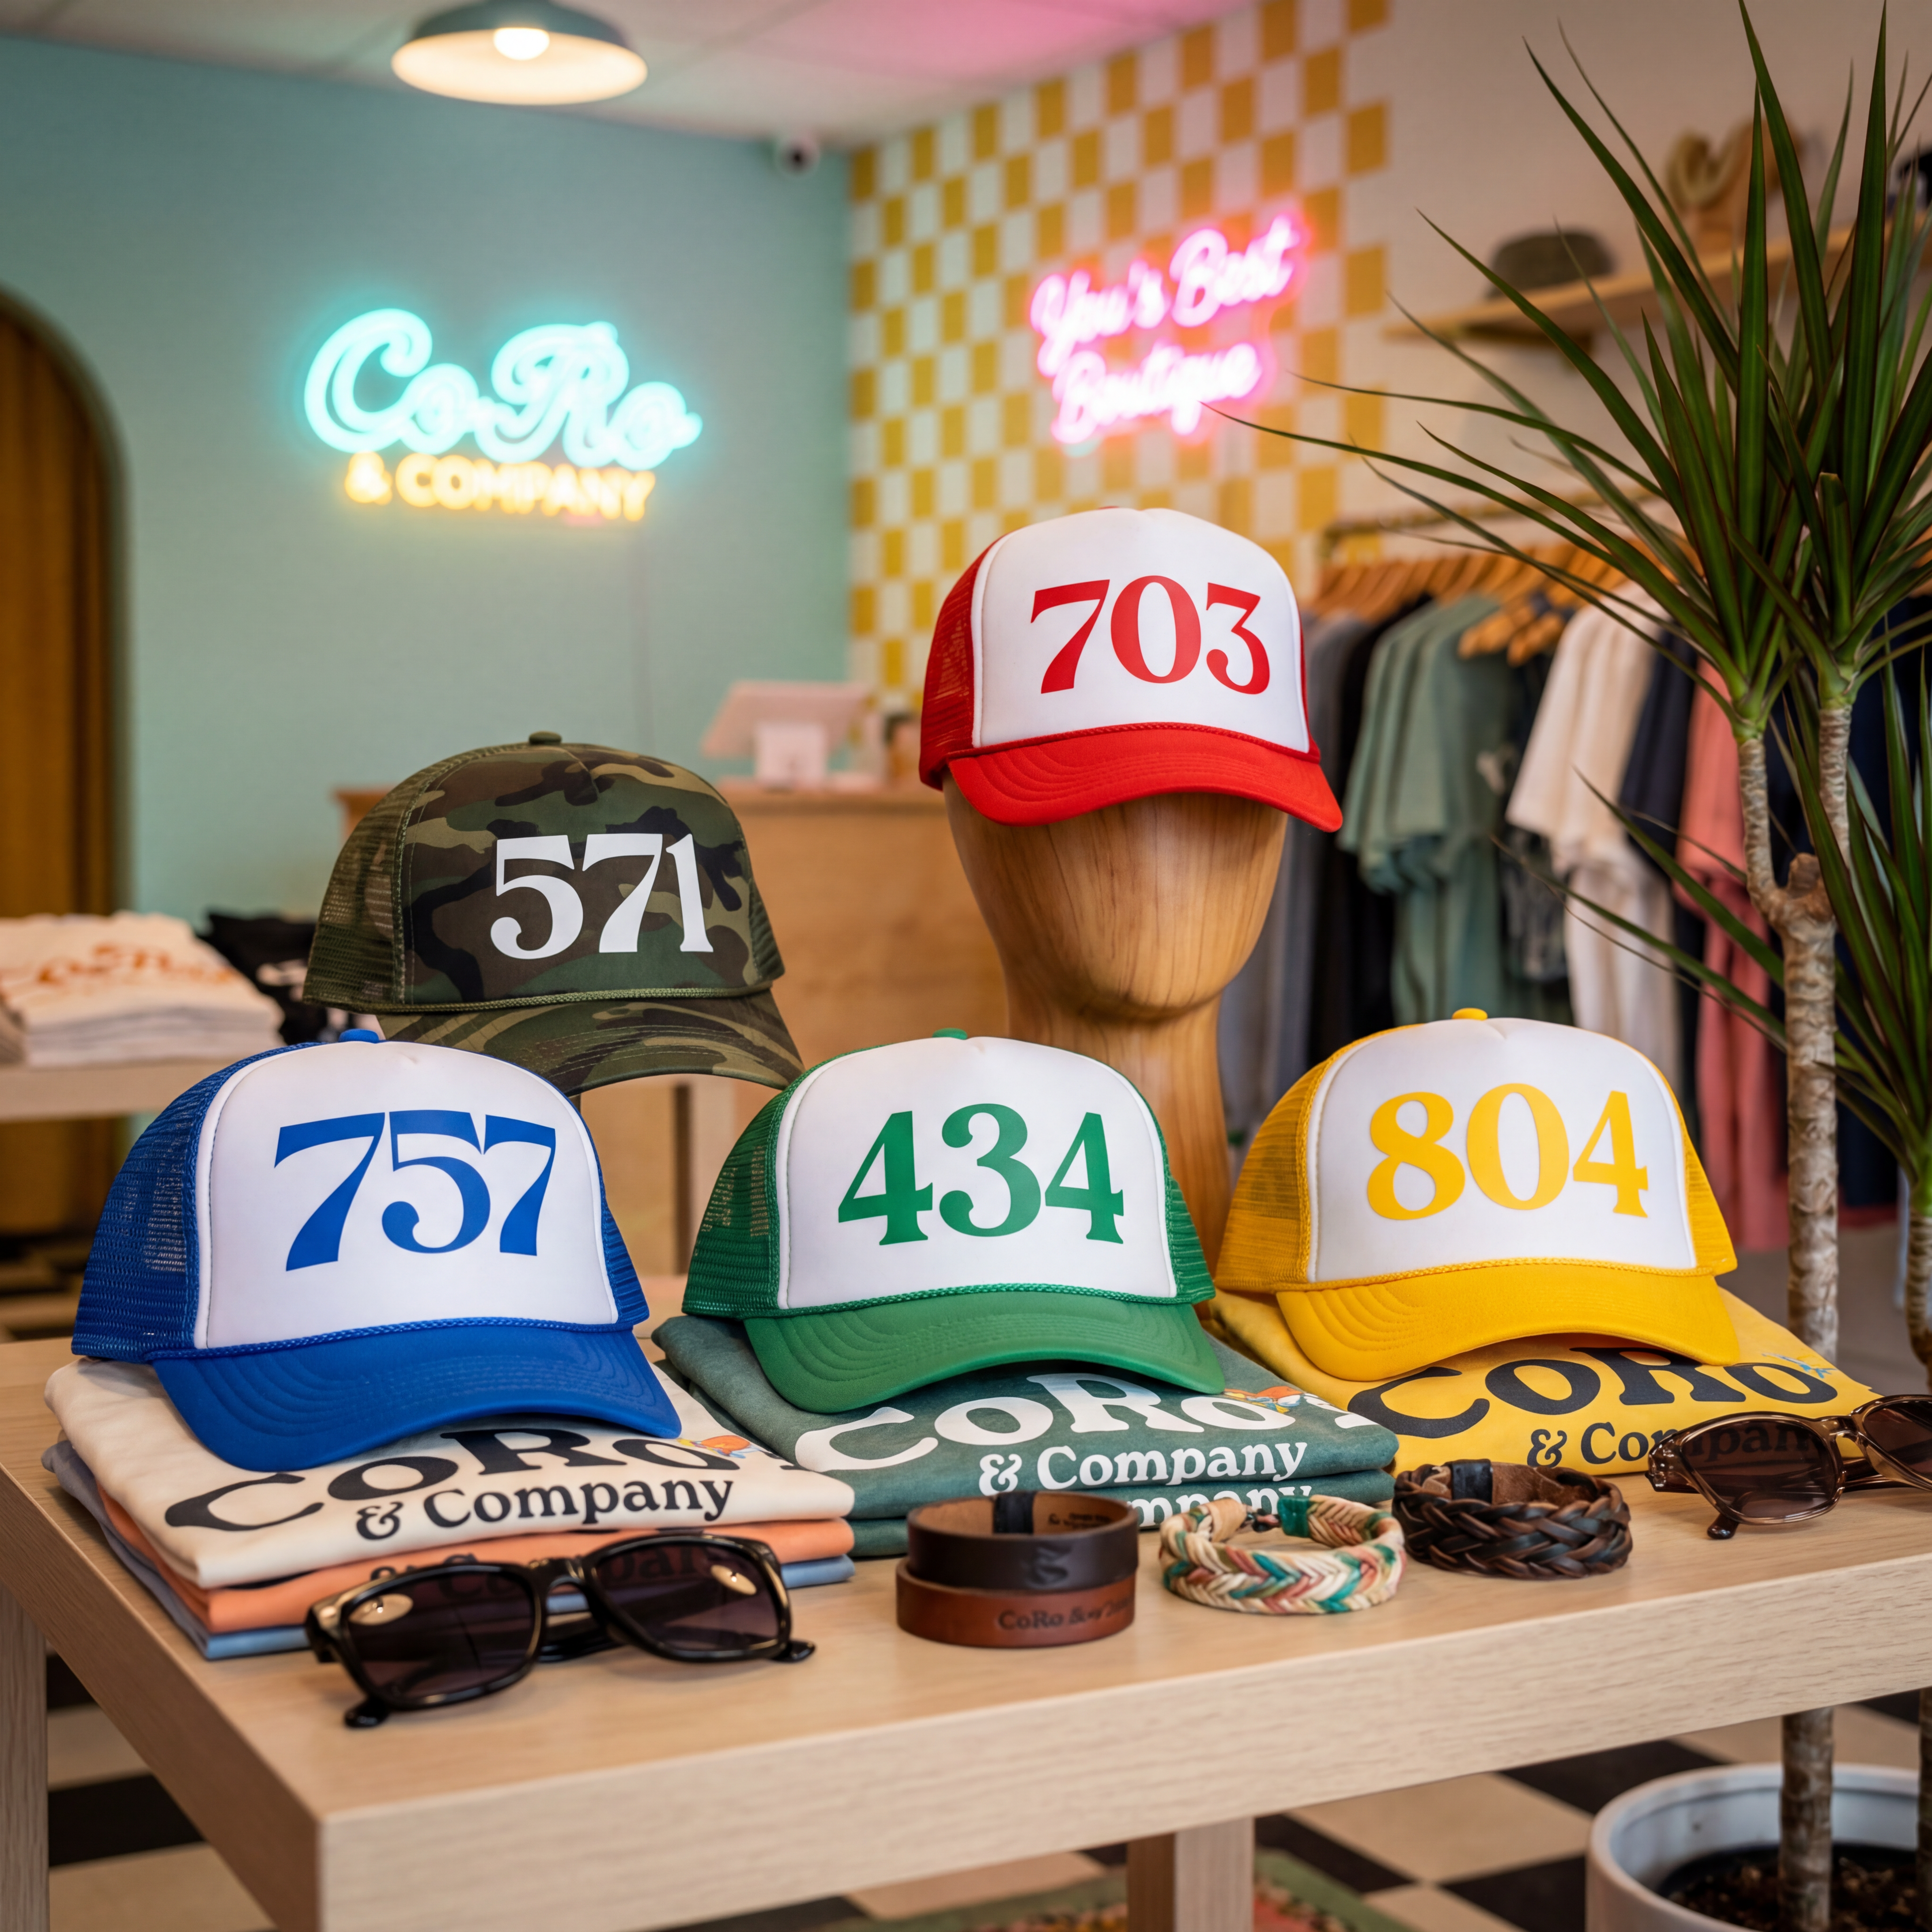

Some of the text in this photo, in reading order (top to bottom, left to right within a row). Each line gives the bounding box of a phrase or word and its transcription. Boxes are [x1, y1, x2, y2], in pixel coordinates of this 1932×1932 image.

[345, 450, 656, 521] & COMPANY
[1030, 575, 1270, 695] 703
[491, 833, 714, 959] 571
[274, 1109, 556, 1271] 757
[838, 1103, 1124, 1246] 434
[1367, 1083, 1648, 1220] 804
[979, 1442, 1308, 1496] & Company
[1527, 1429, 1568, 1468] &
[356, 1479, 734, 1540] & Company
[998, 1609, 1065, 1630] CoRo
